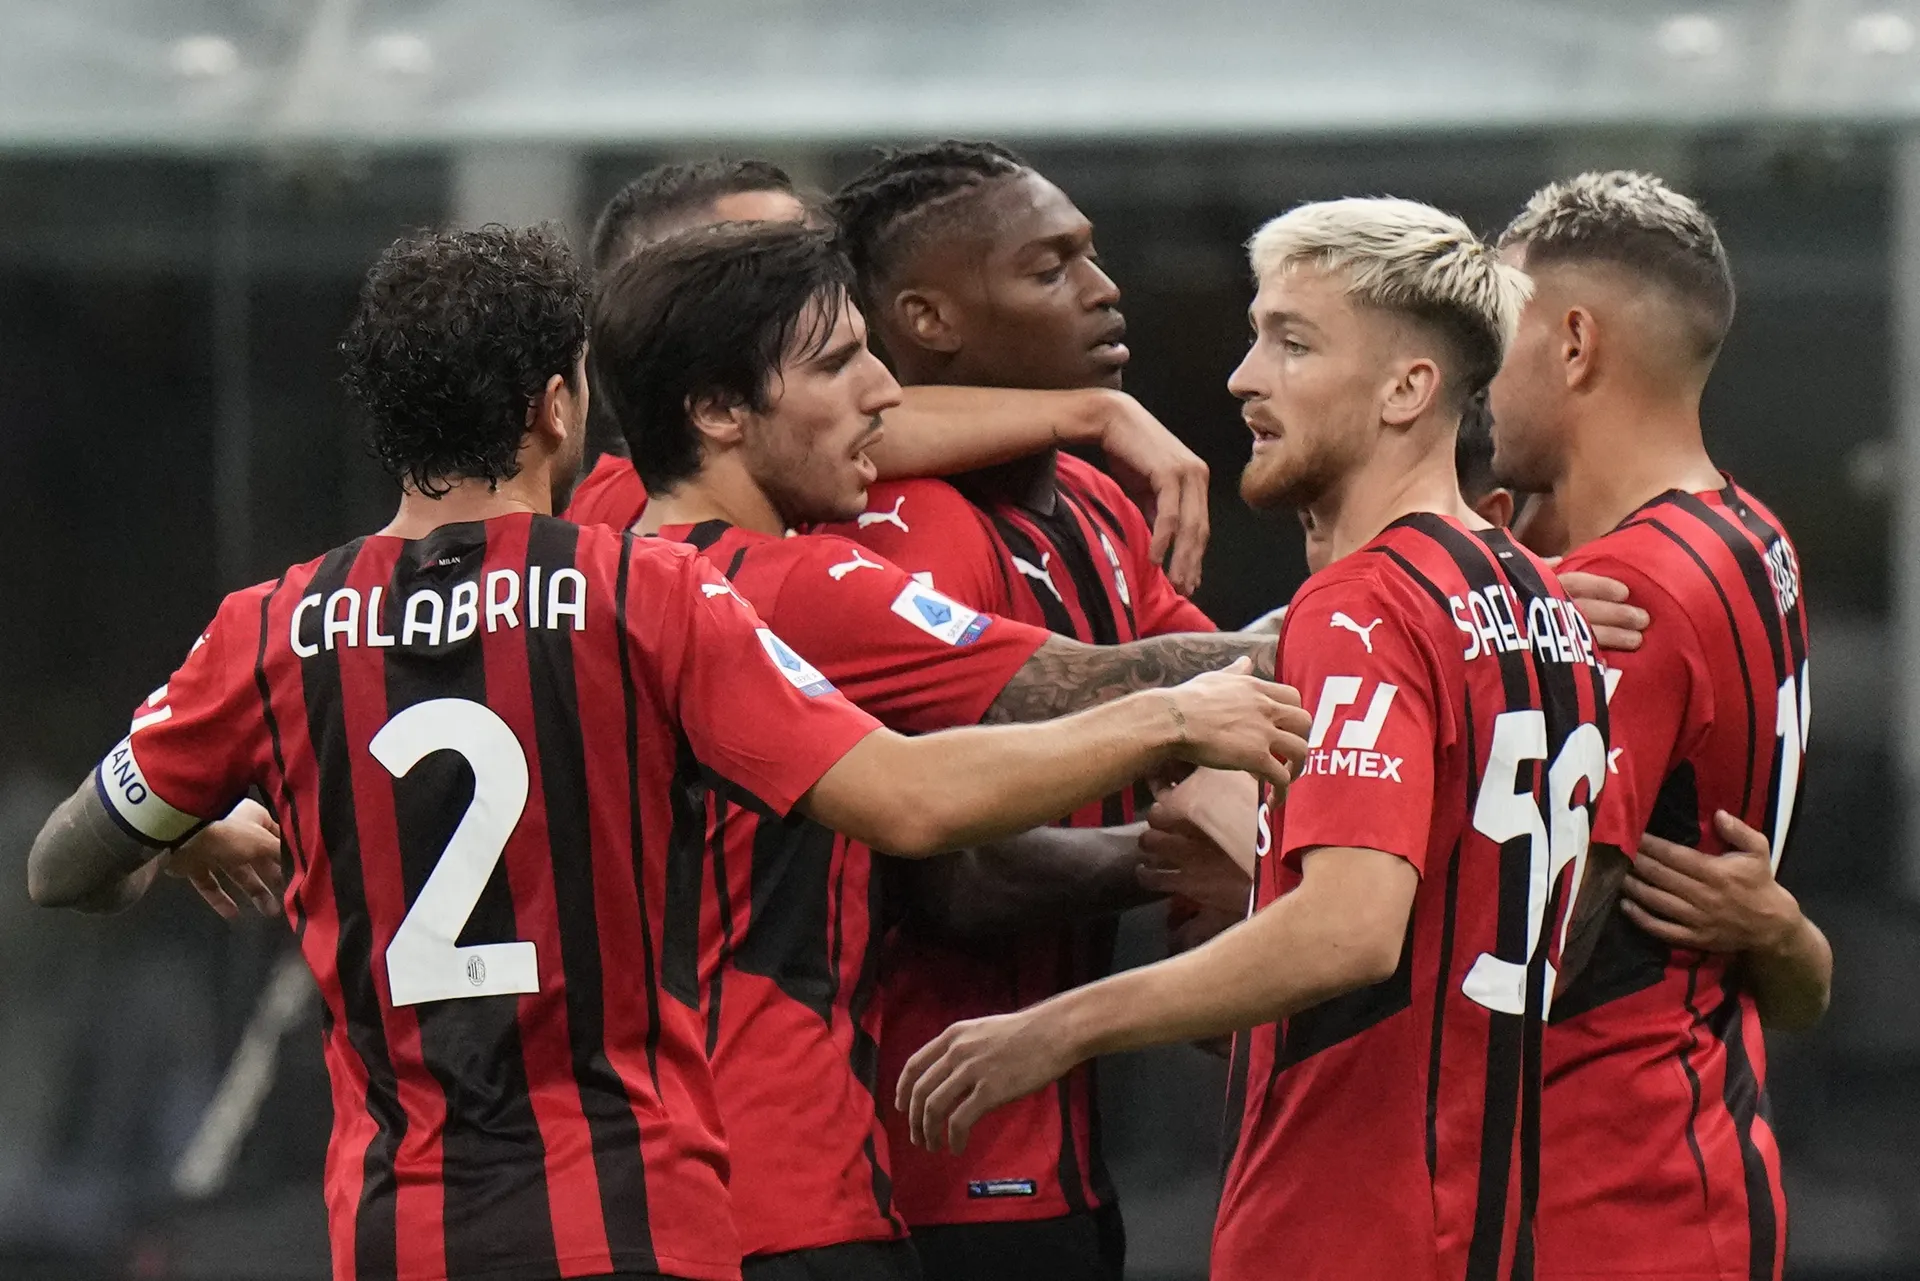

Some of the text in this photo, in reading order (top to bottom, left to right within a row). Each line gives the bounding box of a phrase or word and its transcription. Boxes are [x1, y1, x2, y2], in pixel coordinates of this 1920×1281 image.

[290, 566, 587, 658] CALABRIA
[368, 698, 540, 1007] 2
[1299, 749, 1404, 784] itMEX
[1462, 711, 1606, 1022] 56
